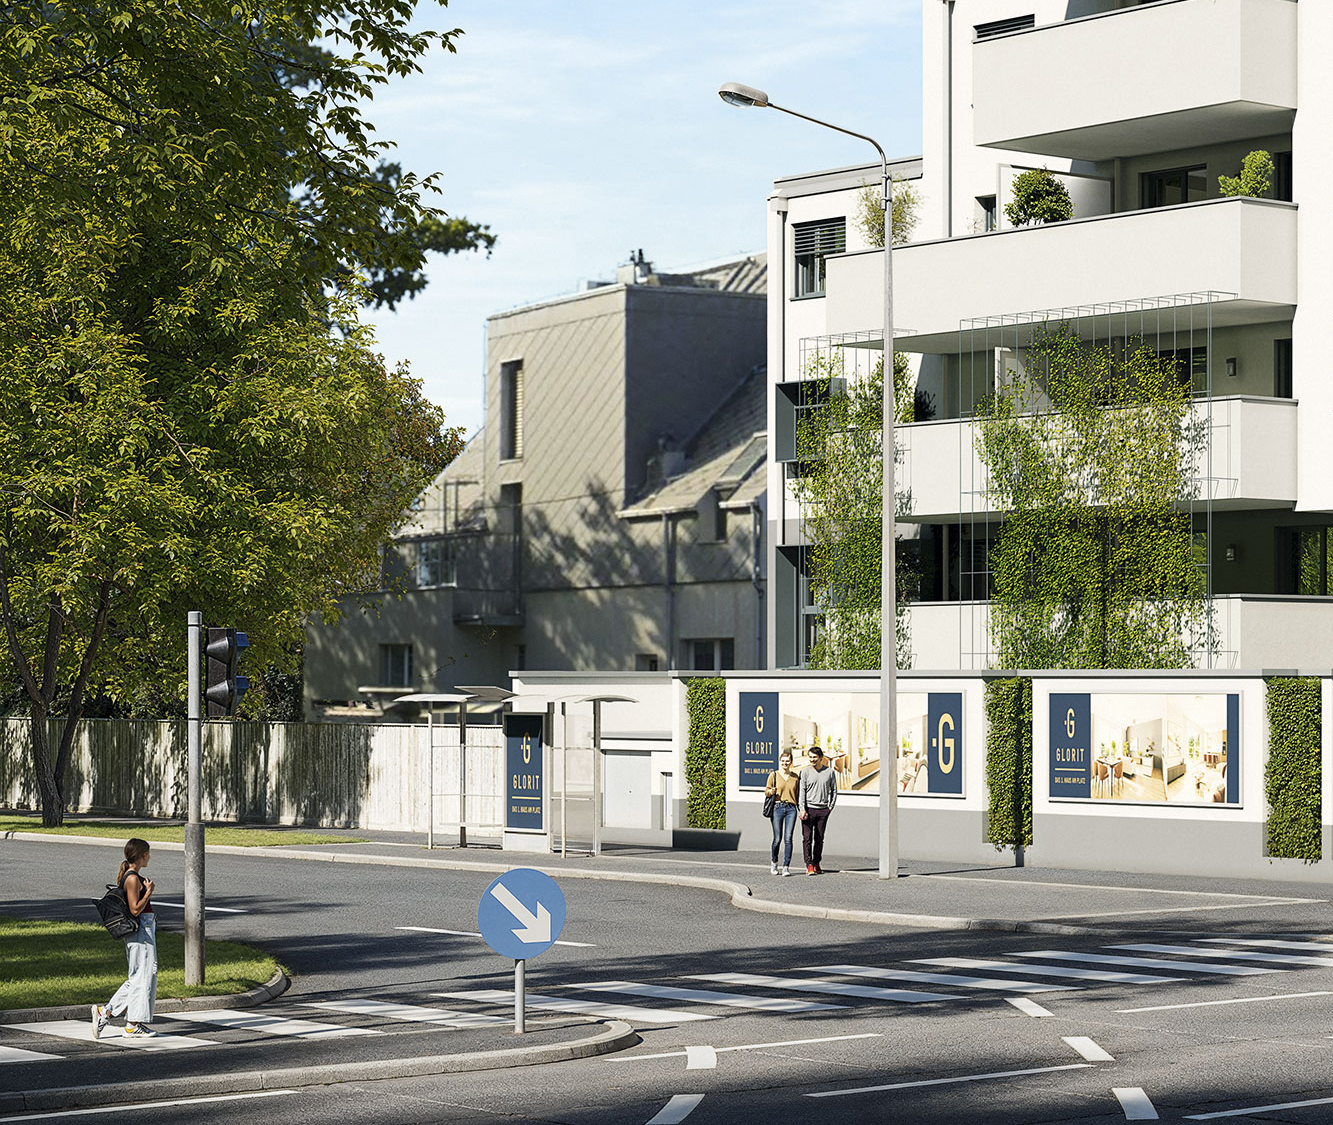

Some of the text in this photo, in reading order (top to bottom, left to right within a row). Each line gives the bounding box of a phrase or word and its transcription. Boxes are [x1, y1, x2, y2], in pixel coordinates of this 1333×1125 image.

[745, 741, 773, 755] GLORIT
[1056, 747, 1085, 762] GLORIT
[513, 774, 540, 789] GLORIT
